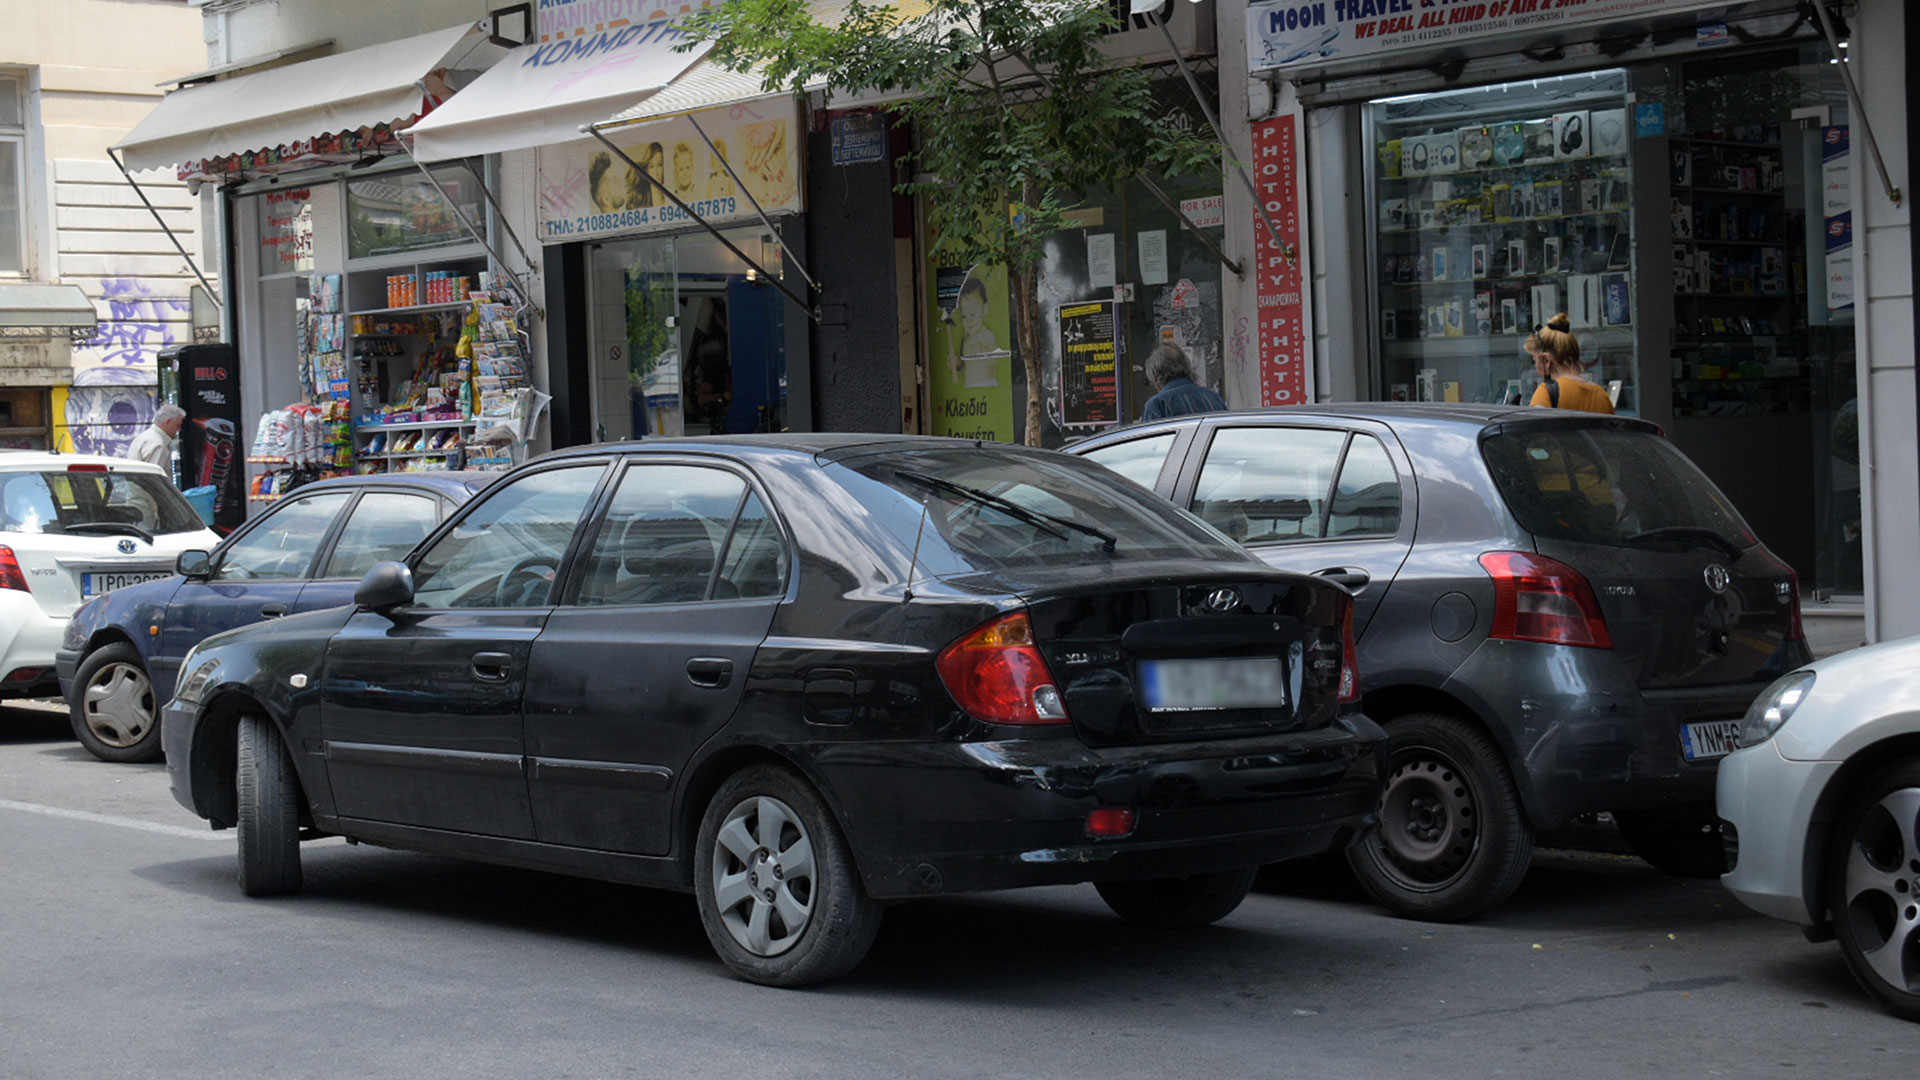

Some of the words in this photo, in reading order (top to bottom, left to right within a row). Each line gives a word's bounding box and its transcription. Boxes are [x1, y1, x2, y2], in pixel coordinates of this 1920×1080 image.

[1270, 3, 1325, 33] MOON
[1335, 0, 1413, 22] TRAVEL
[1355, 21, 1377, 39] WE
[1378, 15, 1414, 36] DEAL
[1417, 10, 1446, 29] ALL
[1449, 3, 1487, 24] KIND
[1489, 0, 1510, 18] OF
[1181, 201, 1198, 213] FOR
[1202, 198, 1223, 211] SALE
[577, 209, 649, 232] 2108824684
[1272, 318, 1291, 401] PHOTO
[945, 395, 987, 417] Κλειδιά
